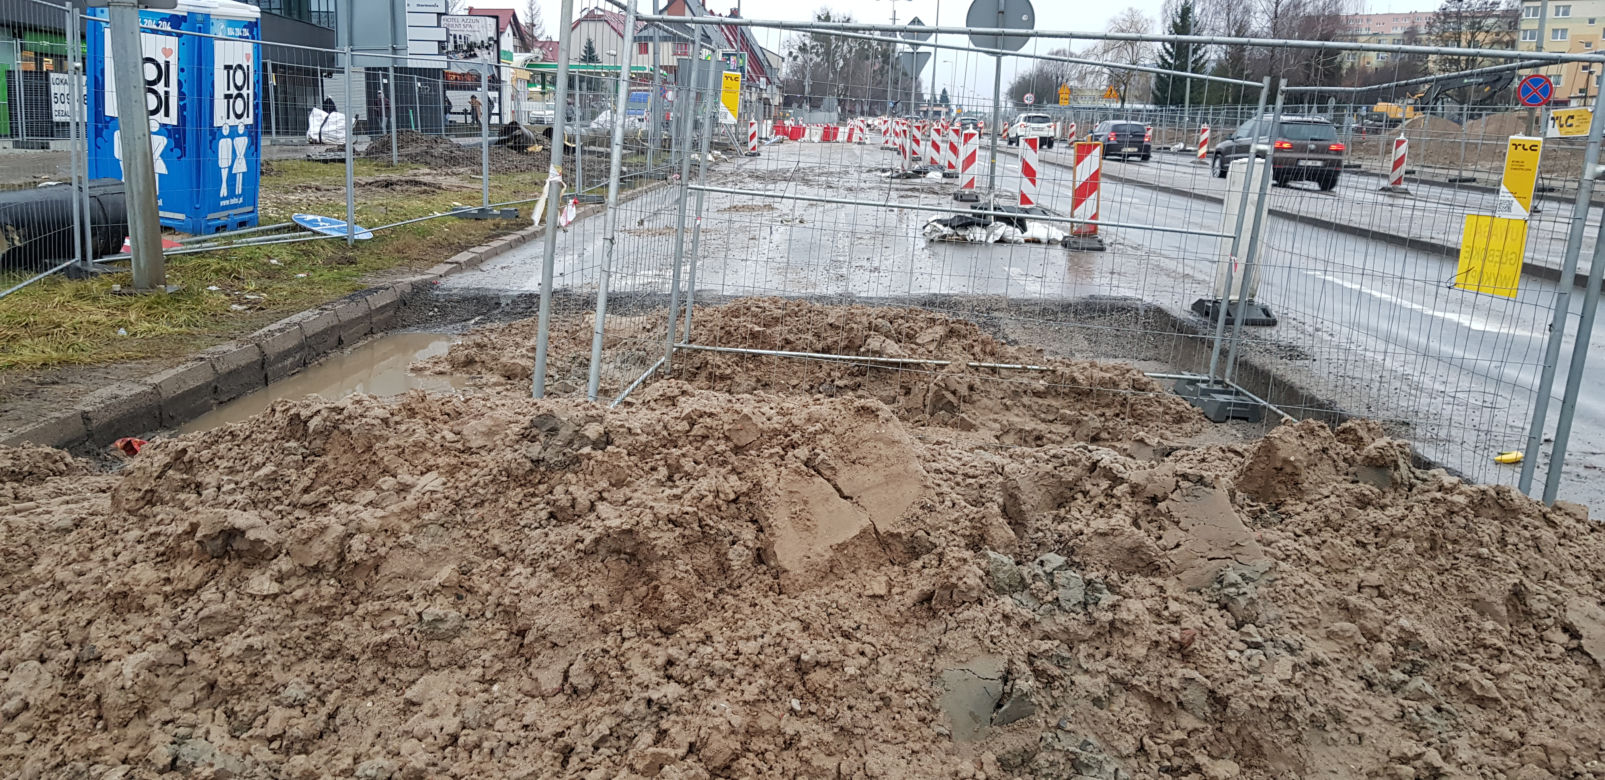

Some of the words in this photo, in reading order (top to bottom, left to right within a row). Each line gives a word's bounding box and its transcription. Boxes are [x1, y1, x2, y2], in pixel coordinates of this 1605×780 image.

[158, 21, 172, 30] 204
[142, 57, 170, 88] OI
[223, 64, 250, 92] TOI
[145, 87, 170, 117] OI
[223, 92, 250, 120] TOI
[1550, 115, 1575, 128] TLC
[1512, 143, 1539, 151] TLC
